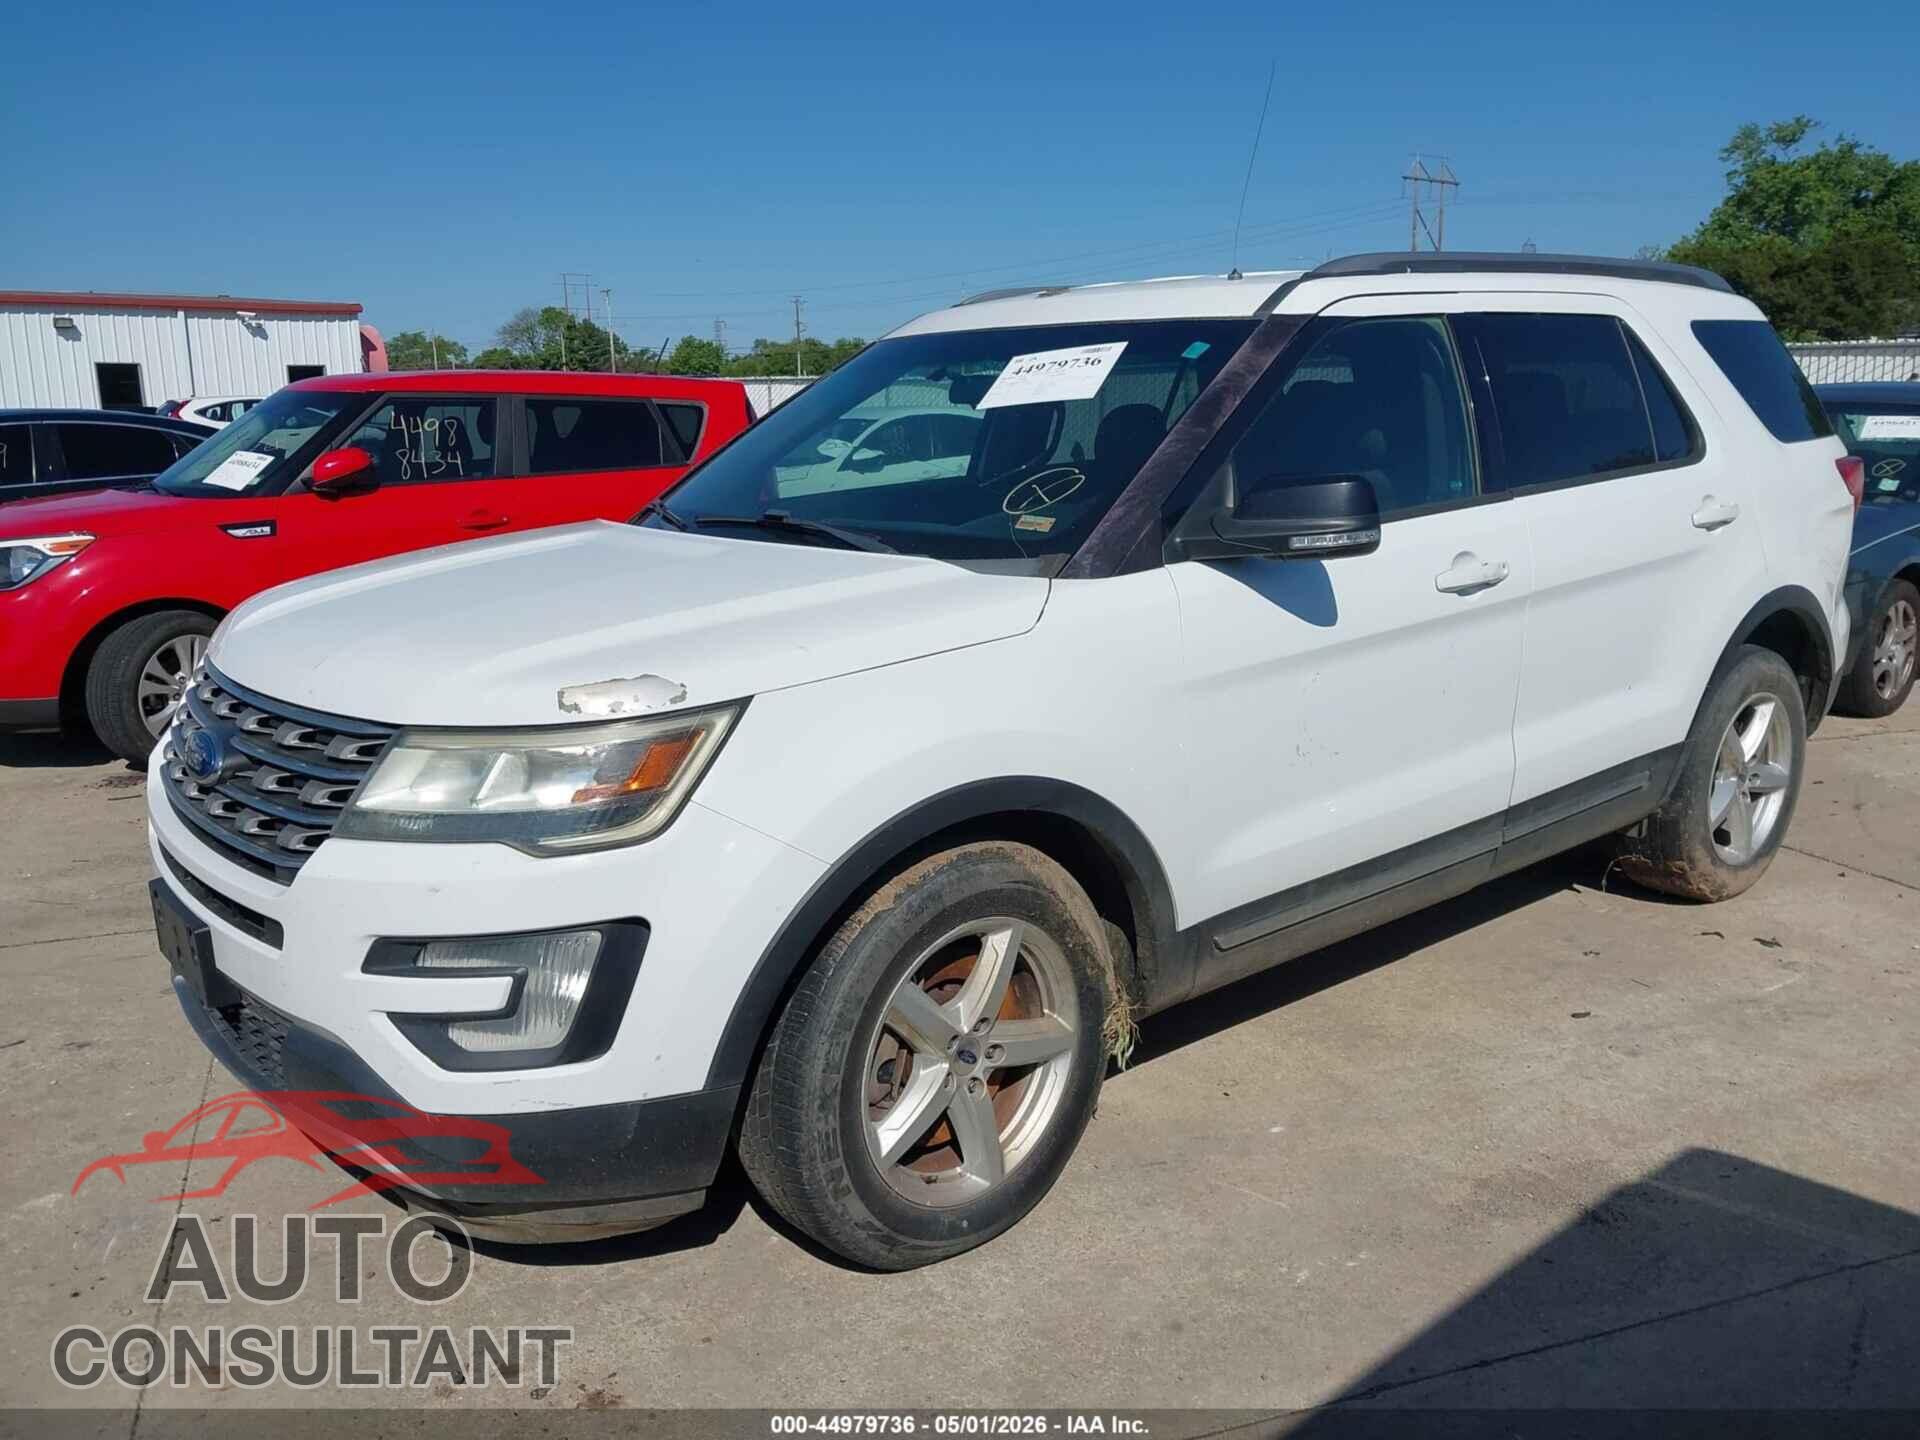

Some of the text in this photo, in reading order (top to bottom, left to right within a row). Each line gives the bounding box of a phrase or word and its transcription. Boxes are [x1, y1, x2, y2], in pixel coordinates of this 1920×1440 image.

[1012, 356, 1102, 375] 44979736
[391, 410, 458, 449] 4498
[395, 448, 464, 480] 8434
